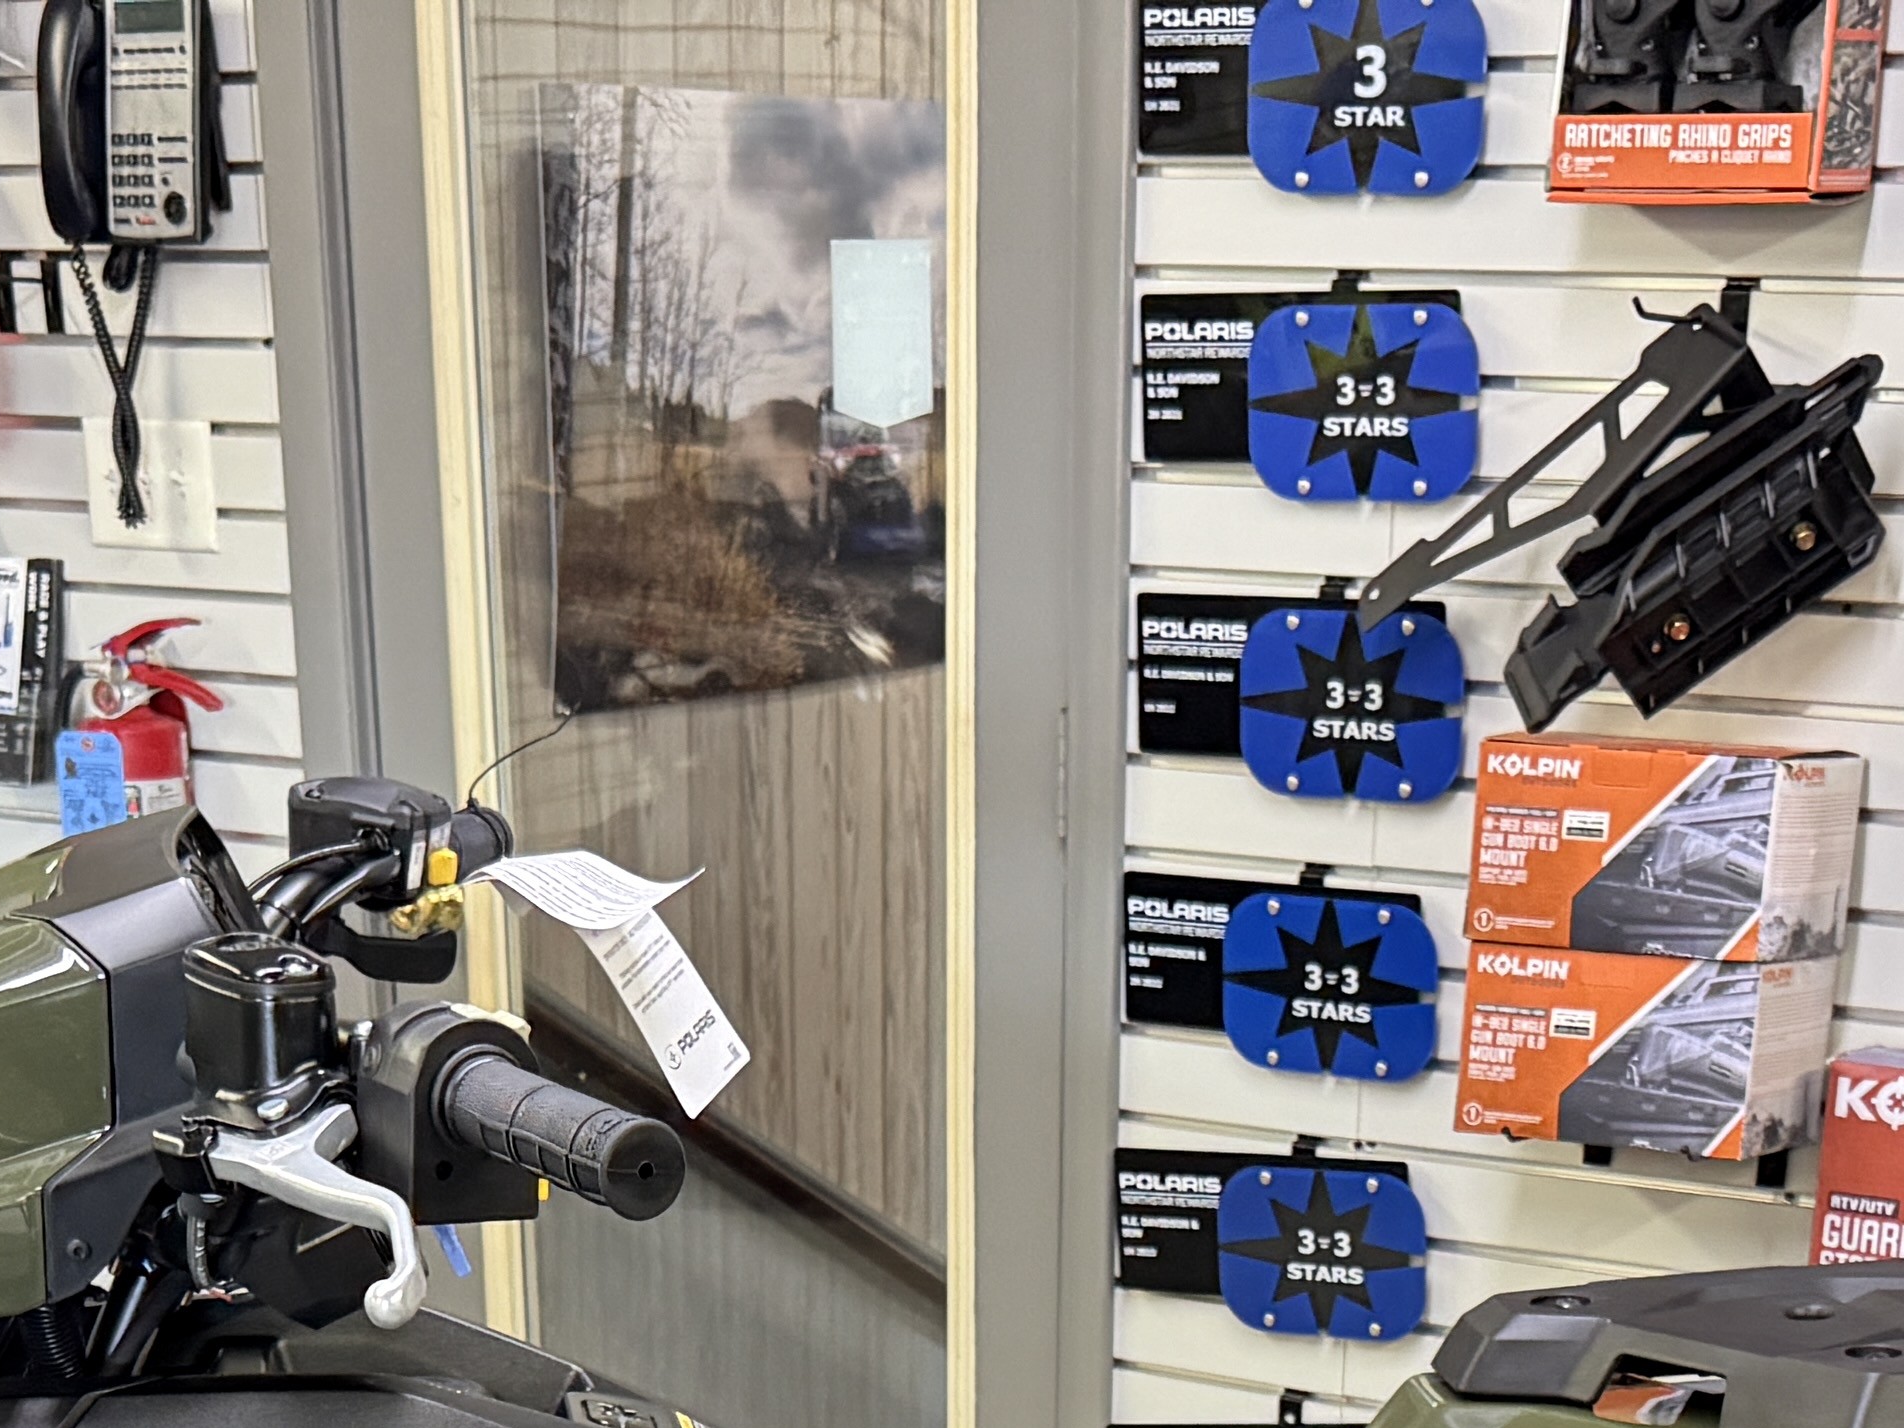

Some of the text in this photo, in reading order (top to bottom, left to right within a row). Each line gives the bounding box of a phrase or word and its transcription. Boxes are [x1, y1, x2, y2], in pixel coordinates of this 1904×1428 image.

[1144, 6, 1257, 28] POLARIS
[1353, 44, 1388, 99] 3
[1333, 106, 1405, 128] STAR
[1564, 123, 1793, 149] RATCHETING RHINO GRIPS
[1144, 321, 1255, 342] POLARIS
[1322, 415, 1410, 438] STARS
[1142, 620, 1249, 641] POLARIS
[1312, 718, 1397, 743] STARS
[1486, 753, 1582, 781] KOLPIN
[1479, 849, 1528, 868] MOUNT
[1127, 897, 1231, 924] POLARIS
[1476, 953, 1571, 980] KOLPIN
[1291, 999, 1373, 1025] STARS
[677, 1009, 718, 1056] POLARIS
[1468, 1044, 1516, 1065] MOUNT
[1118, 1171, 1223, 1195] POLARIS
[1829, 1193, 1897, 1216] ATV/UTV
[1286, 1262, 1365, 1287] STARS
